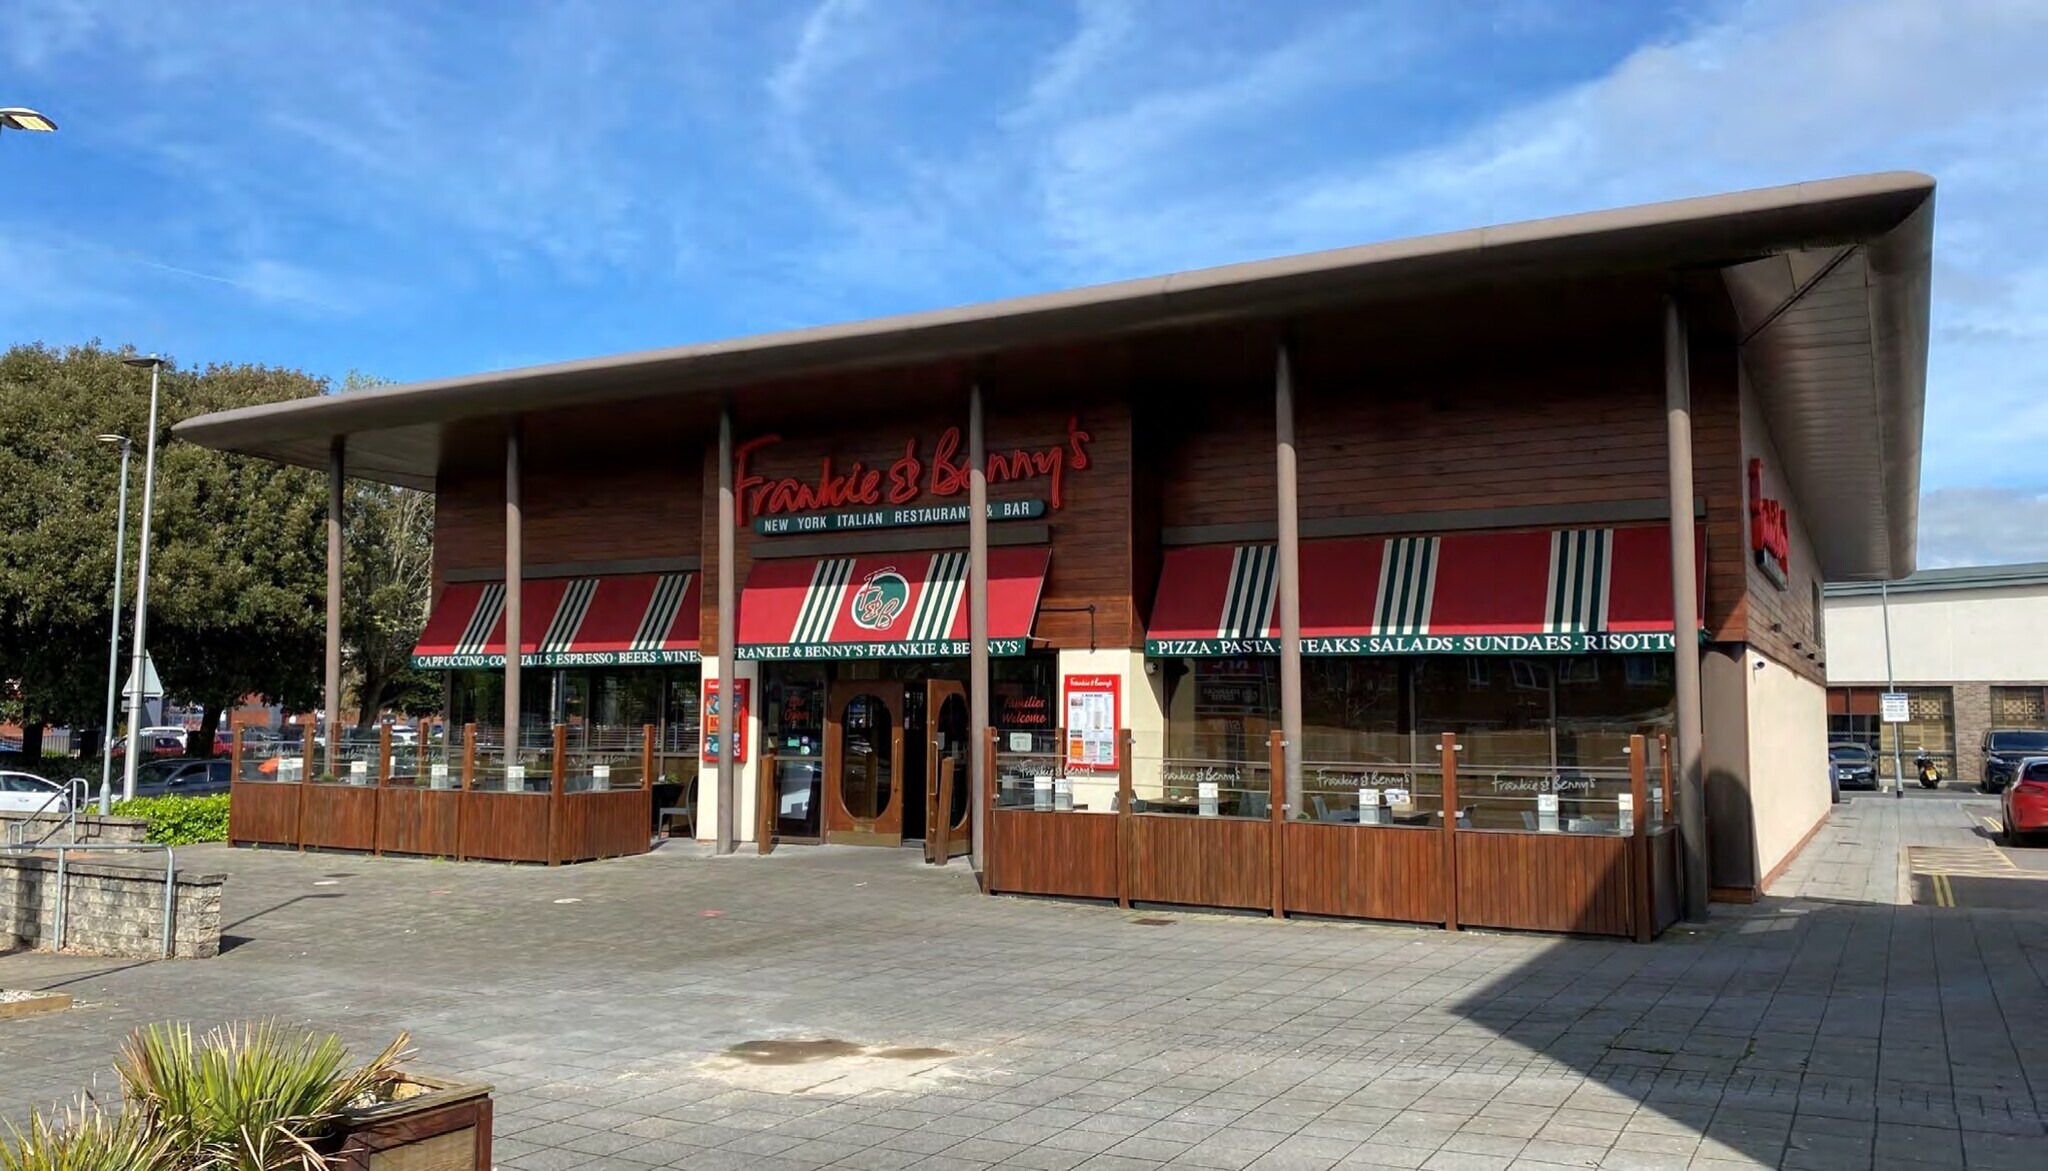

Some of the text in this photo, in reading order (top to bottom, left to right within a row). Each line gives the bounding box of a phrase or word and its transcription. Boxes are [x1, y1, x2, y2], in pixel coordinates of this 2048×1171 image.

[734, 433, 881, 527] Frankie
[889, 438, 921, 504] &
[764, 519, 789, 532] NEW
[797, 516, 827, 529] YORK
[837, 512, 883, 527] ITALIAN
[1004, 501, 1030, 516] BAR
[735, 640, 1018, 659] RANKIE & BENNY'S FRANKIE & BENY'S
[1157, 640, 1212, 654] PIZZA
[1220, 640, 1275, 654] PASTA
[1299, 638, 1361, 653] TEAKS
[1369, 636, 1453, 652] SALADS
[1463, 635, 1572, 651] SUNDAES
[417, 650, 703, 667] CAPPUCCINO COTAILS ESPRESSO BEERS WINES
[1002, 711, 1047, 724] Welcome
[1205, 766, 1241, 787] Benny's
[1316, 768, 1359, 788] Frankie
[1371, 769, 1411, 789] Benny's
[1491, 774, 1538, 793] Frankie
[1552, 774, 1596, 795] Benny's
